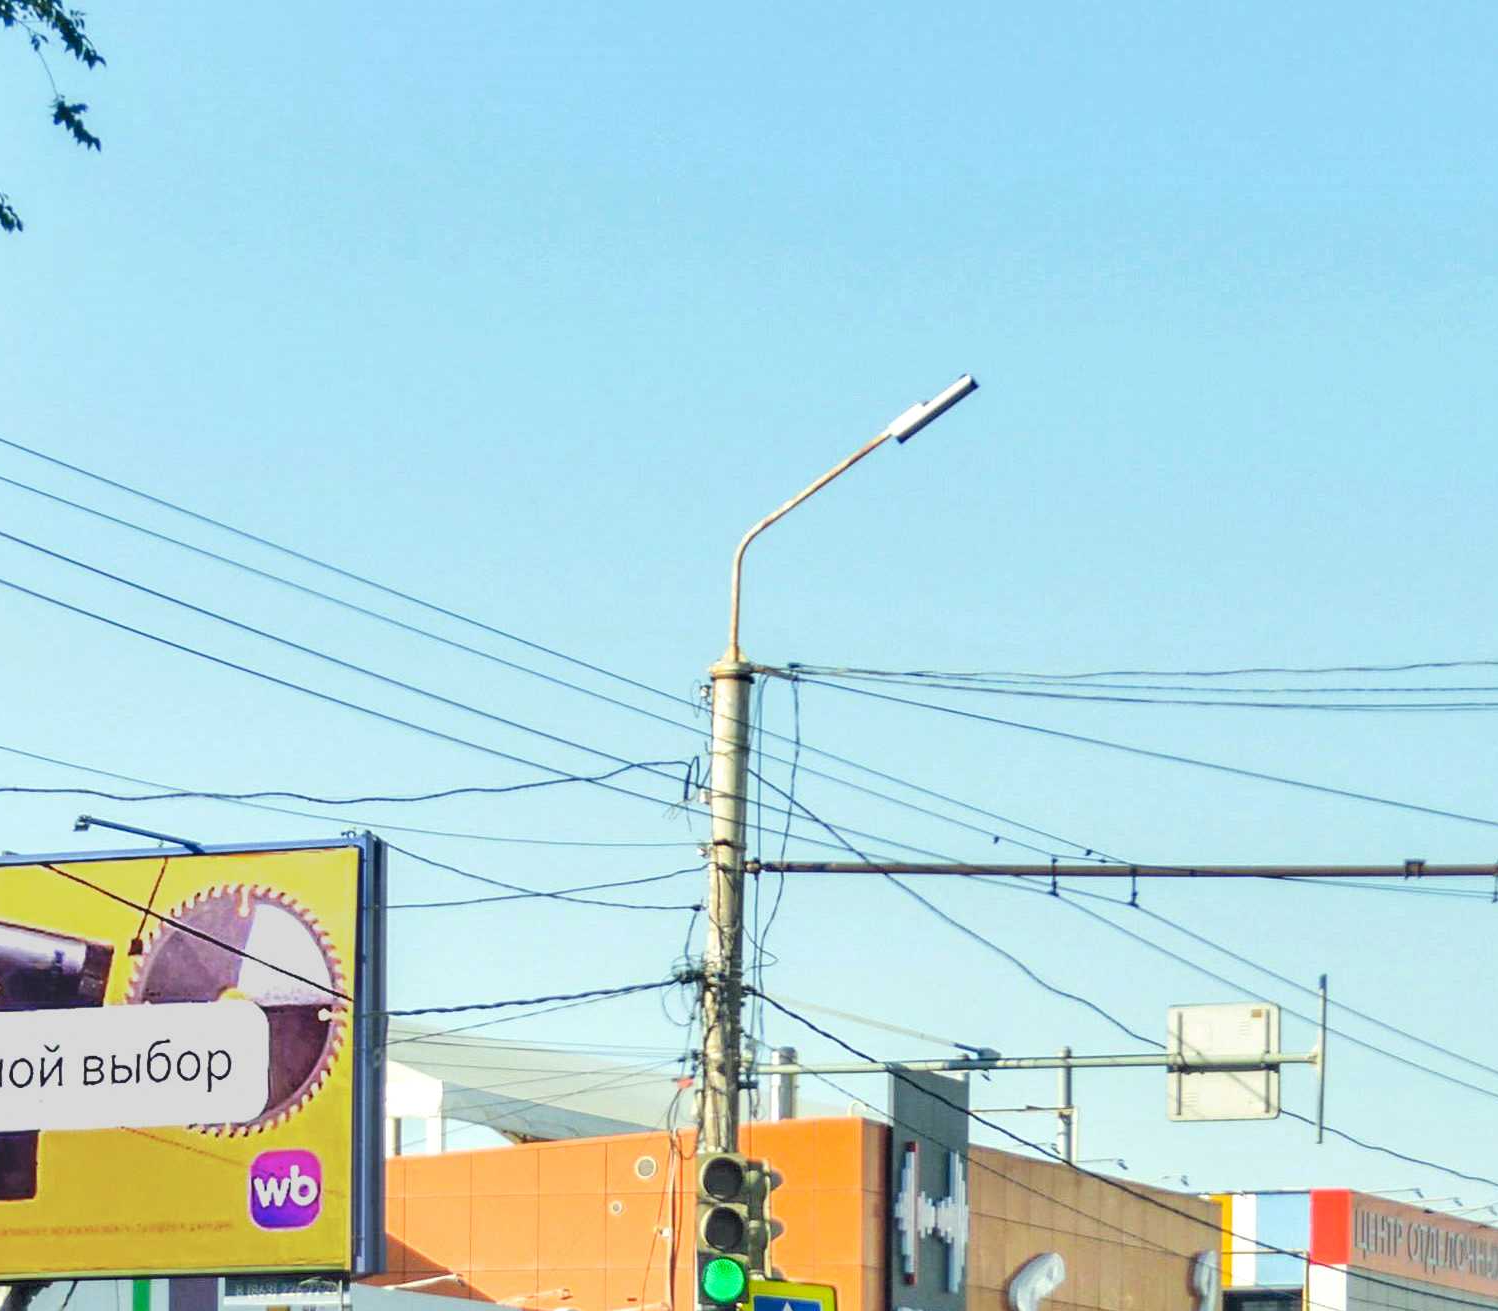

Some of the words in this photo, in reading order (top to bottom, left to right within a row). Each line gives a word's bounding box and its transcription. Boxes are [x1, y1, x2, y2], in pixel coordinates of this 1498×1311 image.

[82, 1038, 232, 1093] выбор
[253, 1164, 318, 1208] wb
[1354, 1207, 1402, 1259] ЦЕНТР
